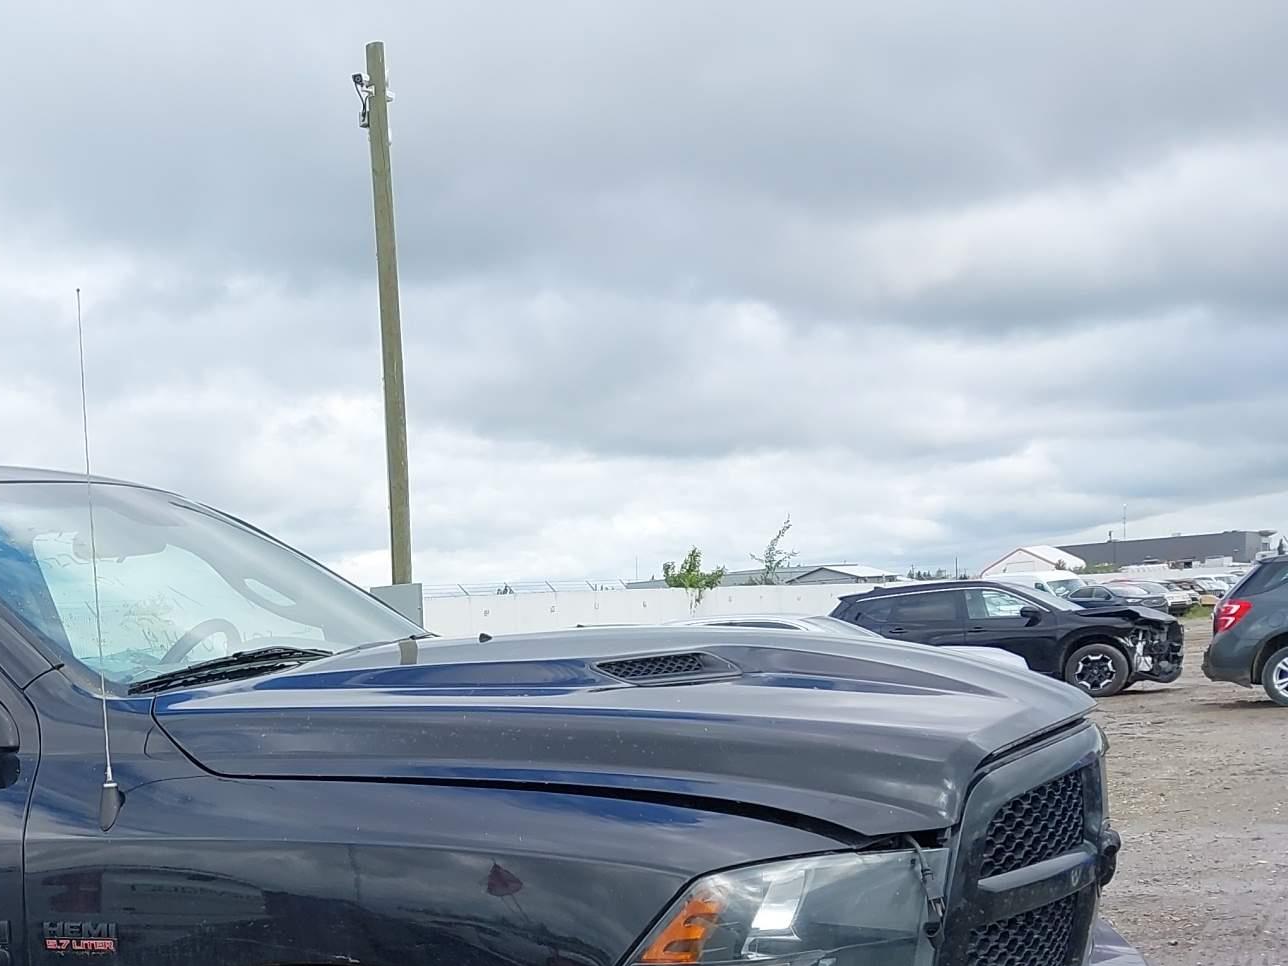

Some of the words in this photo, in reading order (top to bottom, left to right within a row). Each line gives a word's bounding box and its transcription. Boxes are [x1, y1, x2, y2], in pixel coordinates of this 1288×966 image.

[42, 921, 117, 938] HEMI
[45, 939, 71, 949] 5.7
[71, 940, 115, 951] LITER
